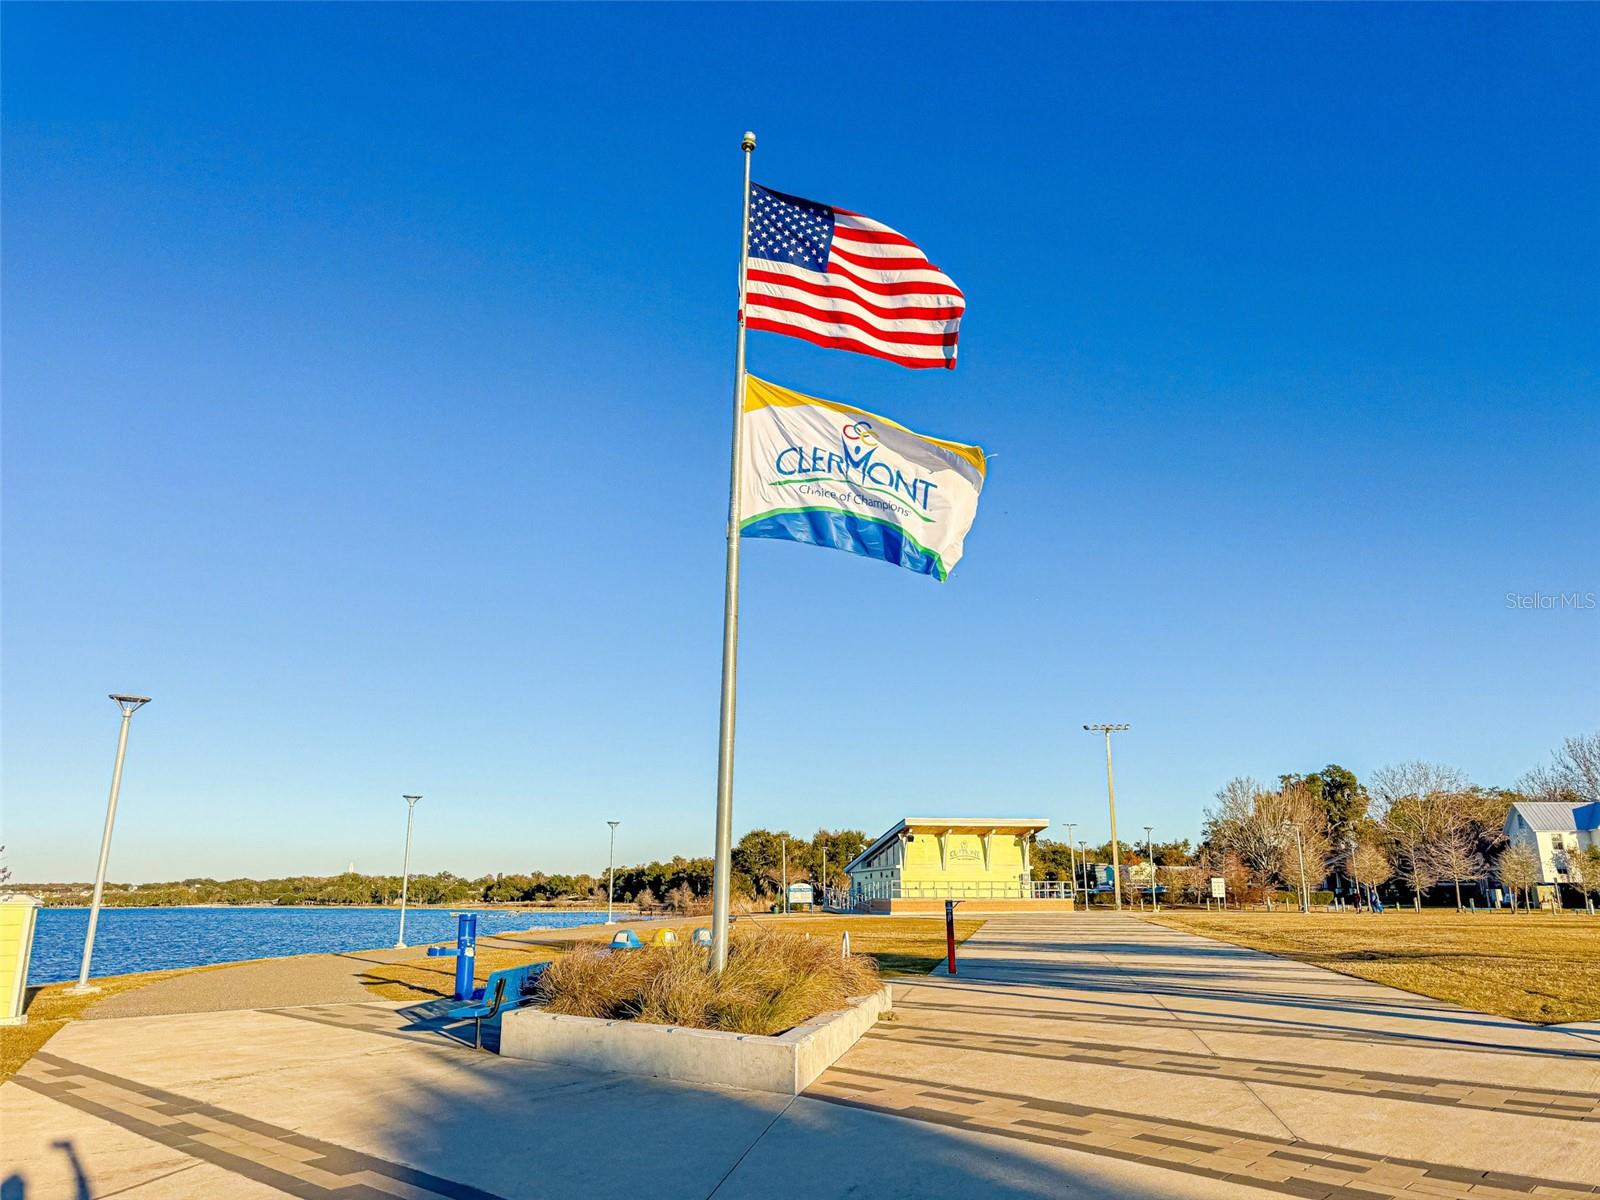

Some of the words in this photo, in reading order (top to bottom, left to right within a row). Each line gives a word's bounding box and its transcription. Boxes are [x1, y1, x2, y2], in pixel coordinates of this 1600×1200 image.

[776, 433, 937, 510] CLERMONT
[799, 484, 836, 499] Choice
[840, 491, 852, 502] of
[853, 494, 910, 517] Champions
